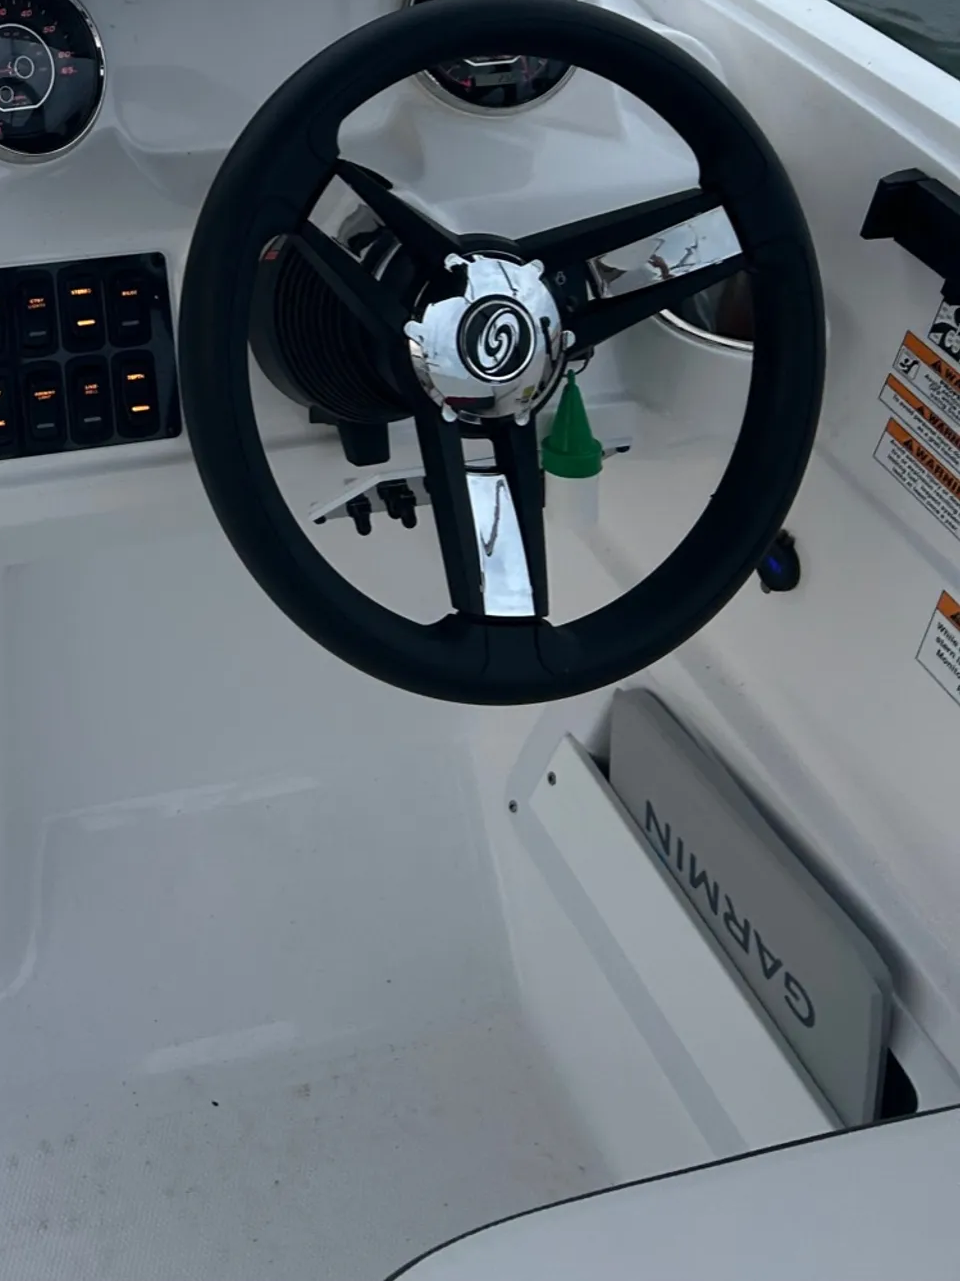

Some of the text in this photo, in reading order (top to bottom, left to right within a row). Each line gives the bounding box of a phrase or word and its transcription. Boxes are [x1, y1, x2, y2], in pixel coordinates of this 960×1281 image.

[938, 622, 958, 646] While
[936, 636, 955, 658] stern
[645, 799, 815, 1028] GARMIN
